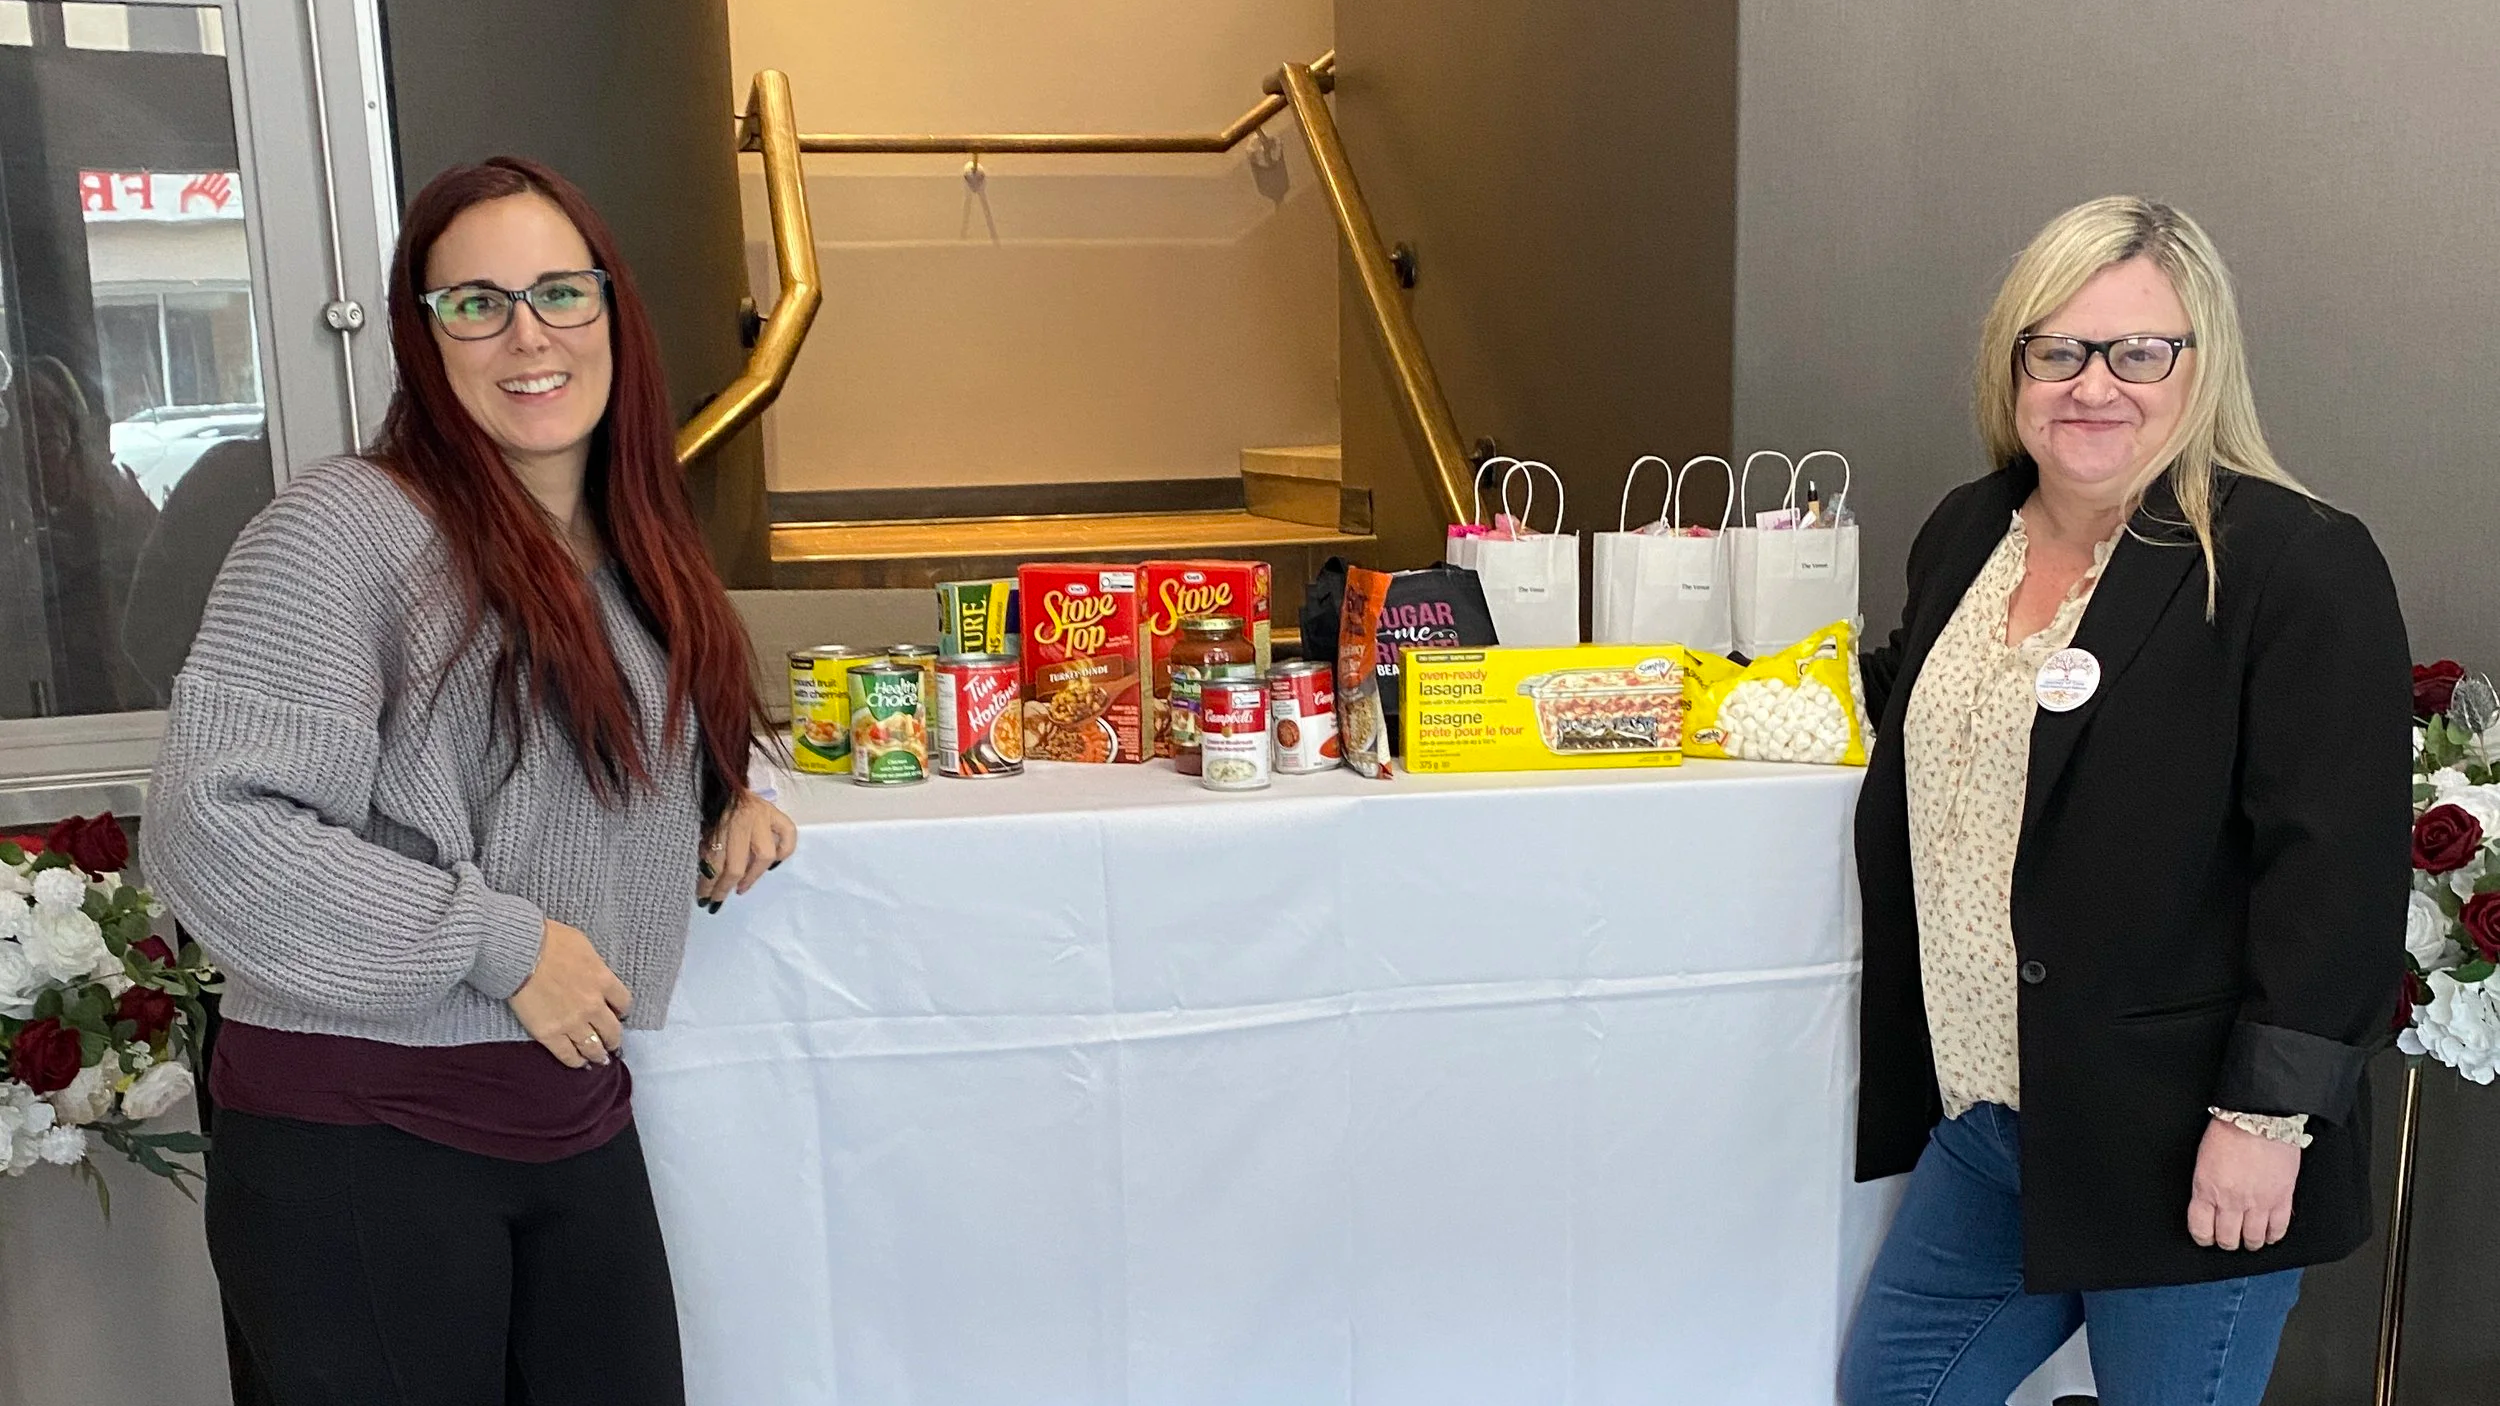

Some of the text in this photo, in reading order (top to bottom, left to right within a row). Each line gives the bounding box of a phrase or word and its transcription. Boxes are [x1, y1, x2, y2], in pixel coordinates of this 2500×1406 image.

[1034, 590, 1117, 644] Stove
[1151, 578, 1233, 635] Stove
[1376, 602, 1455, 629] UGAR
[1062, 622, 1106, 658] Top
[1419, 669, 1487, 681] oven-ready
[1638, 660, 1666, 673] Simply
[963, 675, 998, 702] Tim
[1419, 681, 1483, 698] lasagna
[866, 692, 918, 708] Choice
[967, 680, 1019, 733] Hortons
[1419, 711, 1483, 727] lasagne
[1454, 728, 1482, 739] pour
[1486, 725, 1496, 736] le
[1500, 724, 1524, 736] four
